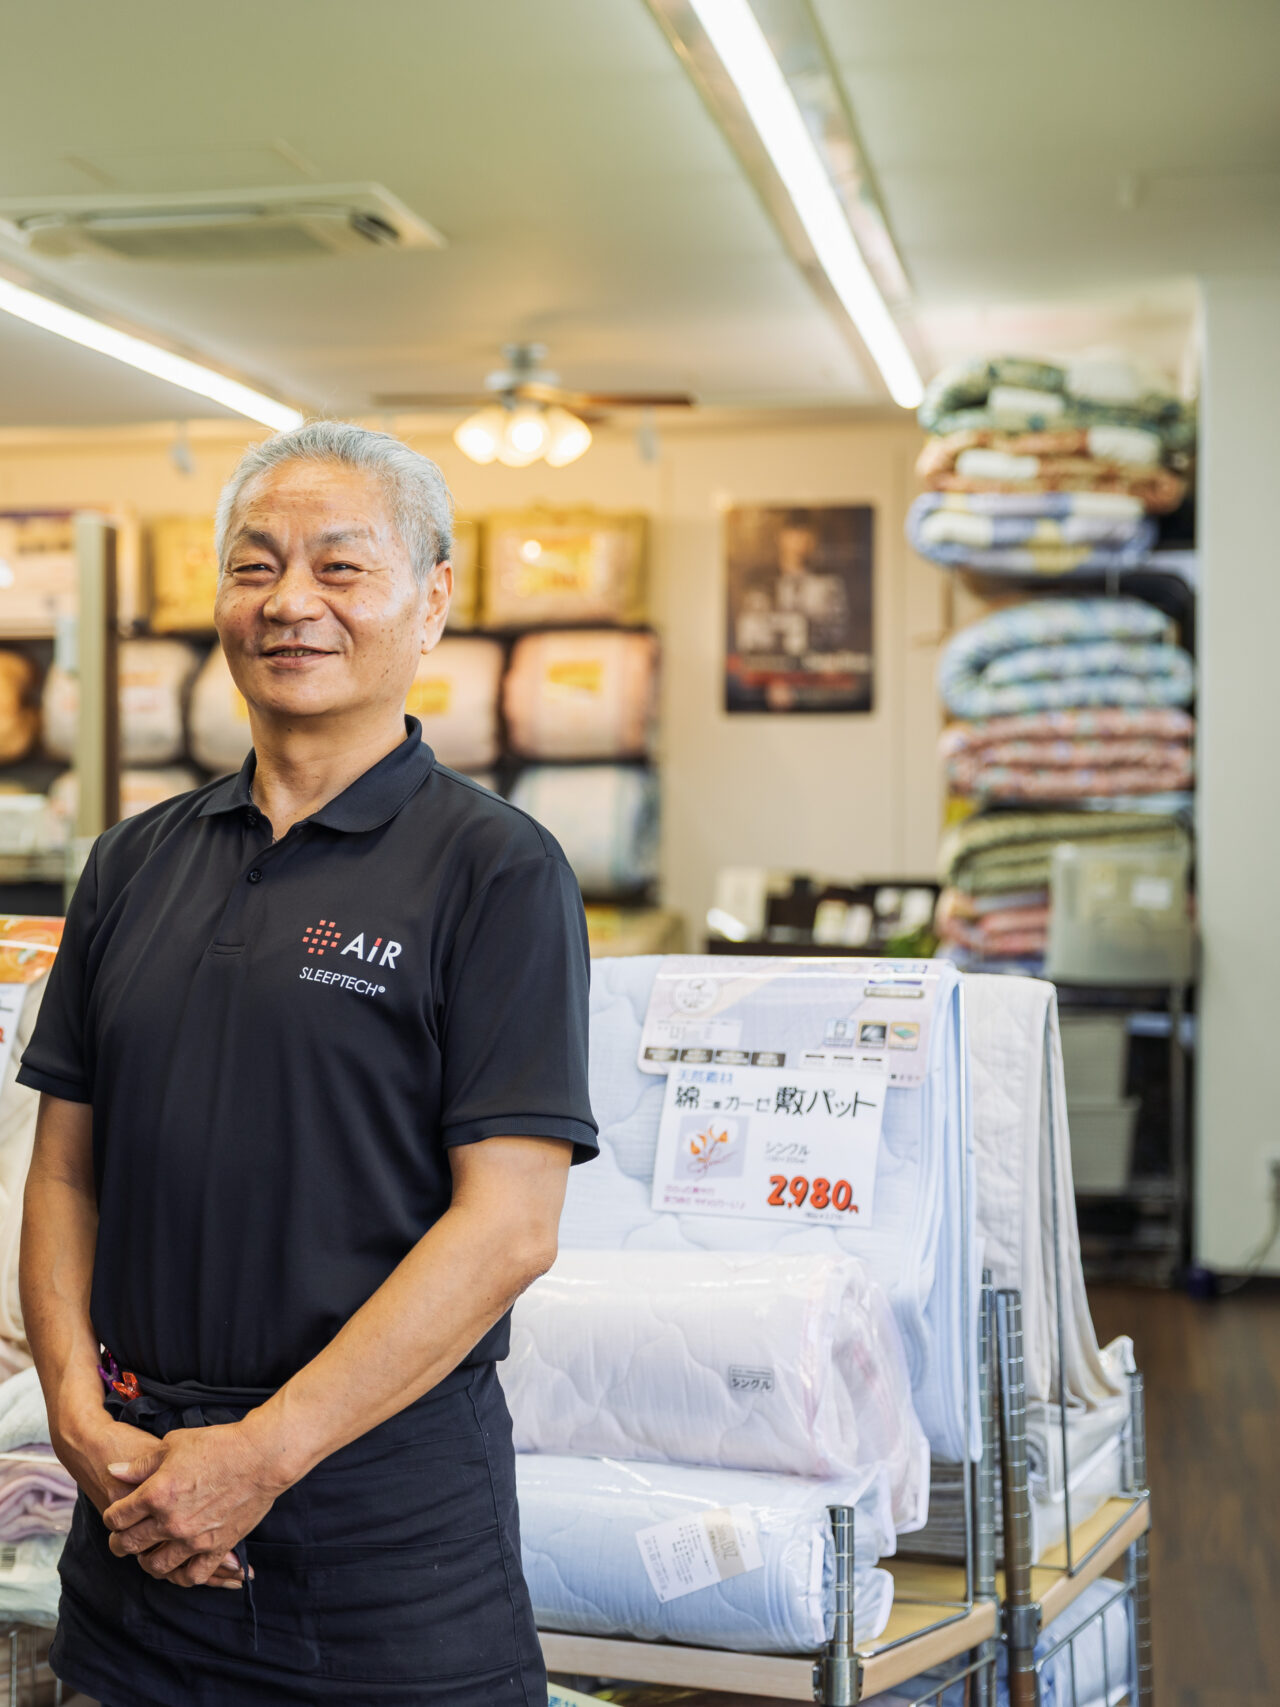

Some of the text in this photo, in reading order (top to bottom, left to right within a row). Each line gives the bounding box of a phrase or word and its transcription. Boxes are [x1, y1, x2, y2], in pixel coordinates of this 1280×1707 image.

[340, 932, 402, 969] AiR
[732, 1378, 771, 1391] シングル
